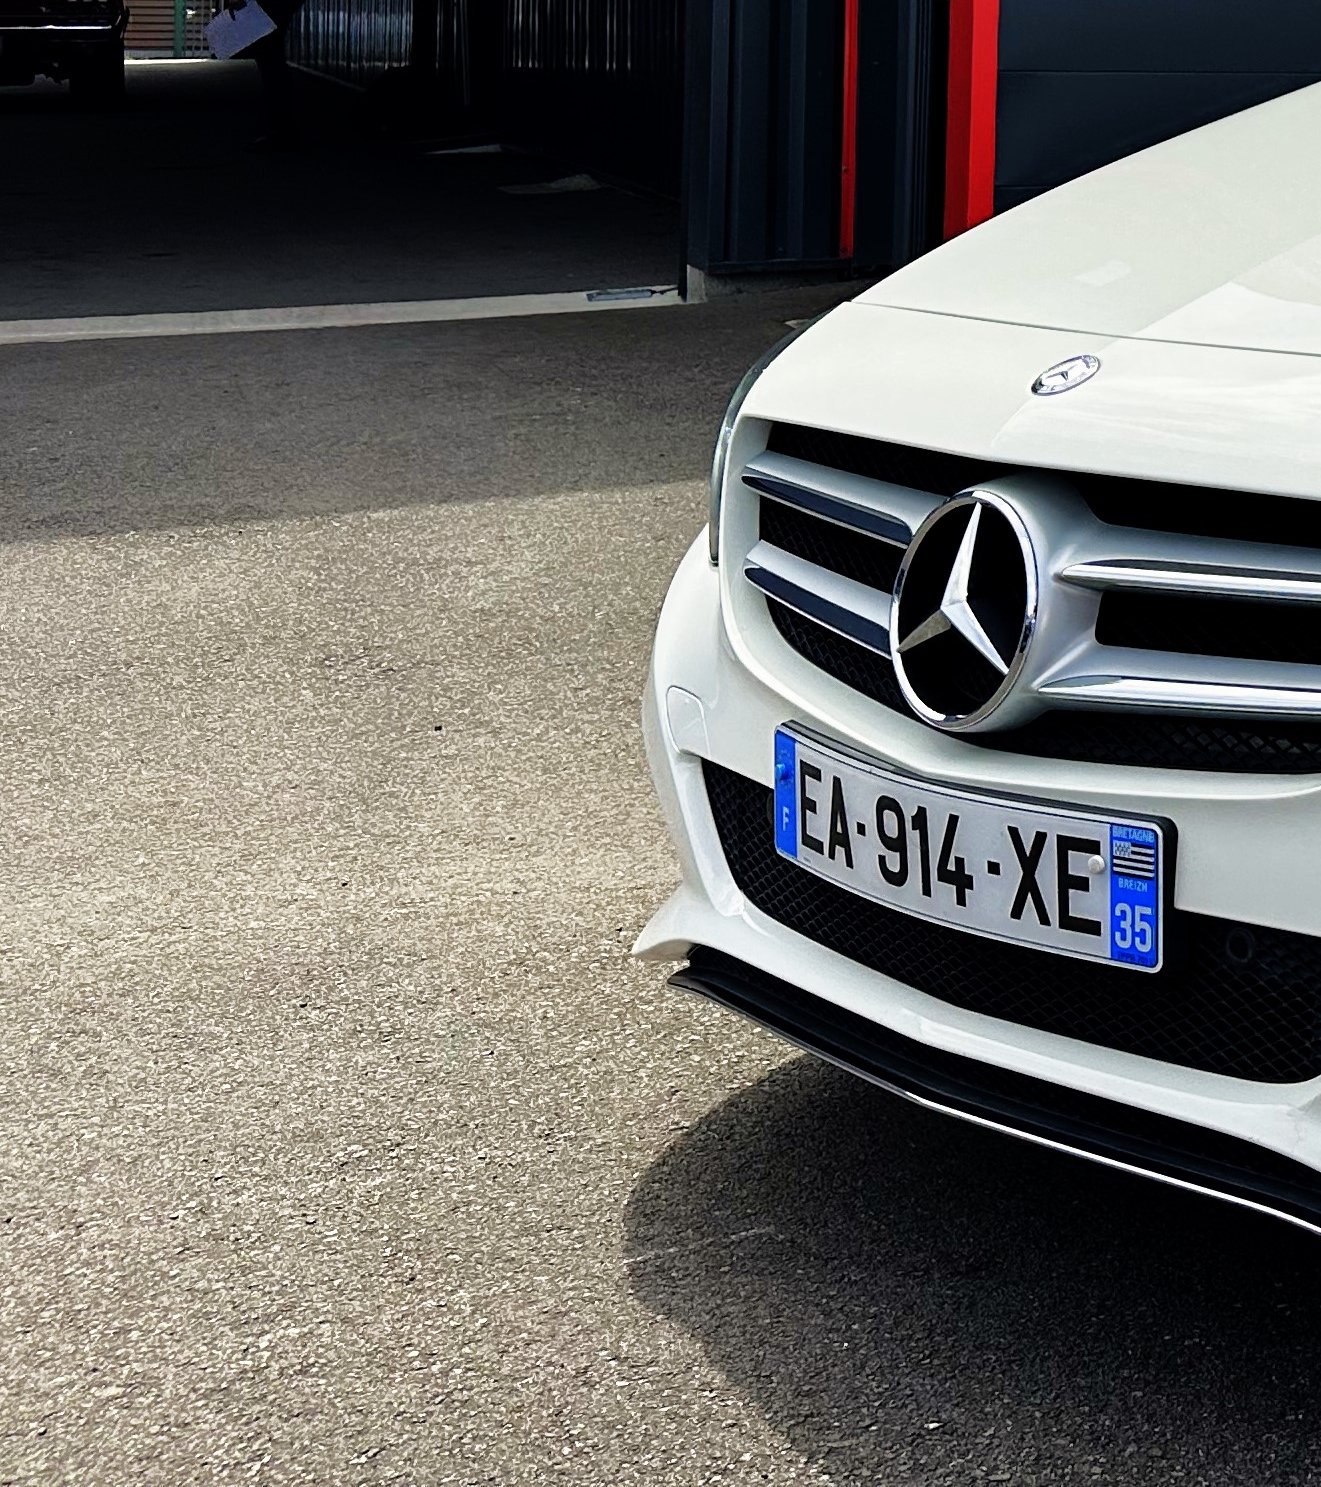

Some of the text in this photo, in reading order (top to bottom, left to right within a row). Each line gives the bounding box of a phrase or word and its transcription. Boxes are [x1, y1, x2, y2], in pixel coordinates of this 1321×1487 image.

[782, 805, 790, 831] F
[1112, 825, 1155, 843] BRETAGNE
[800, 758, 1102, 937] EA-914-XE
[1114, 902, 1153, 953] 35
